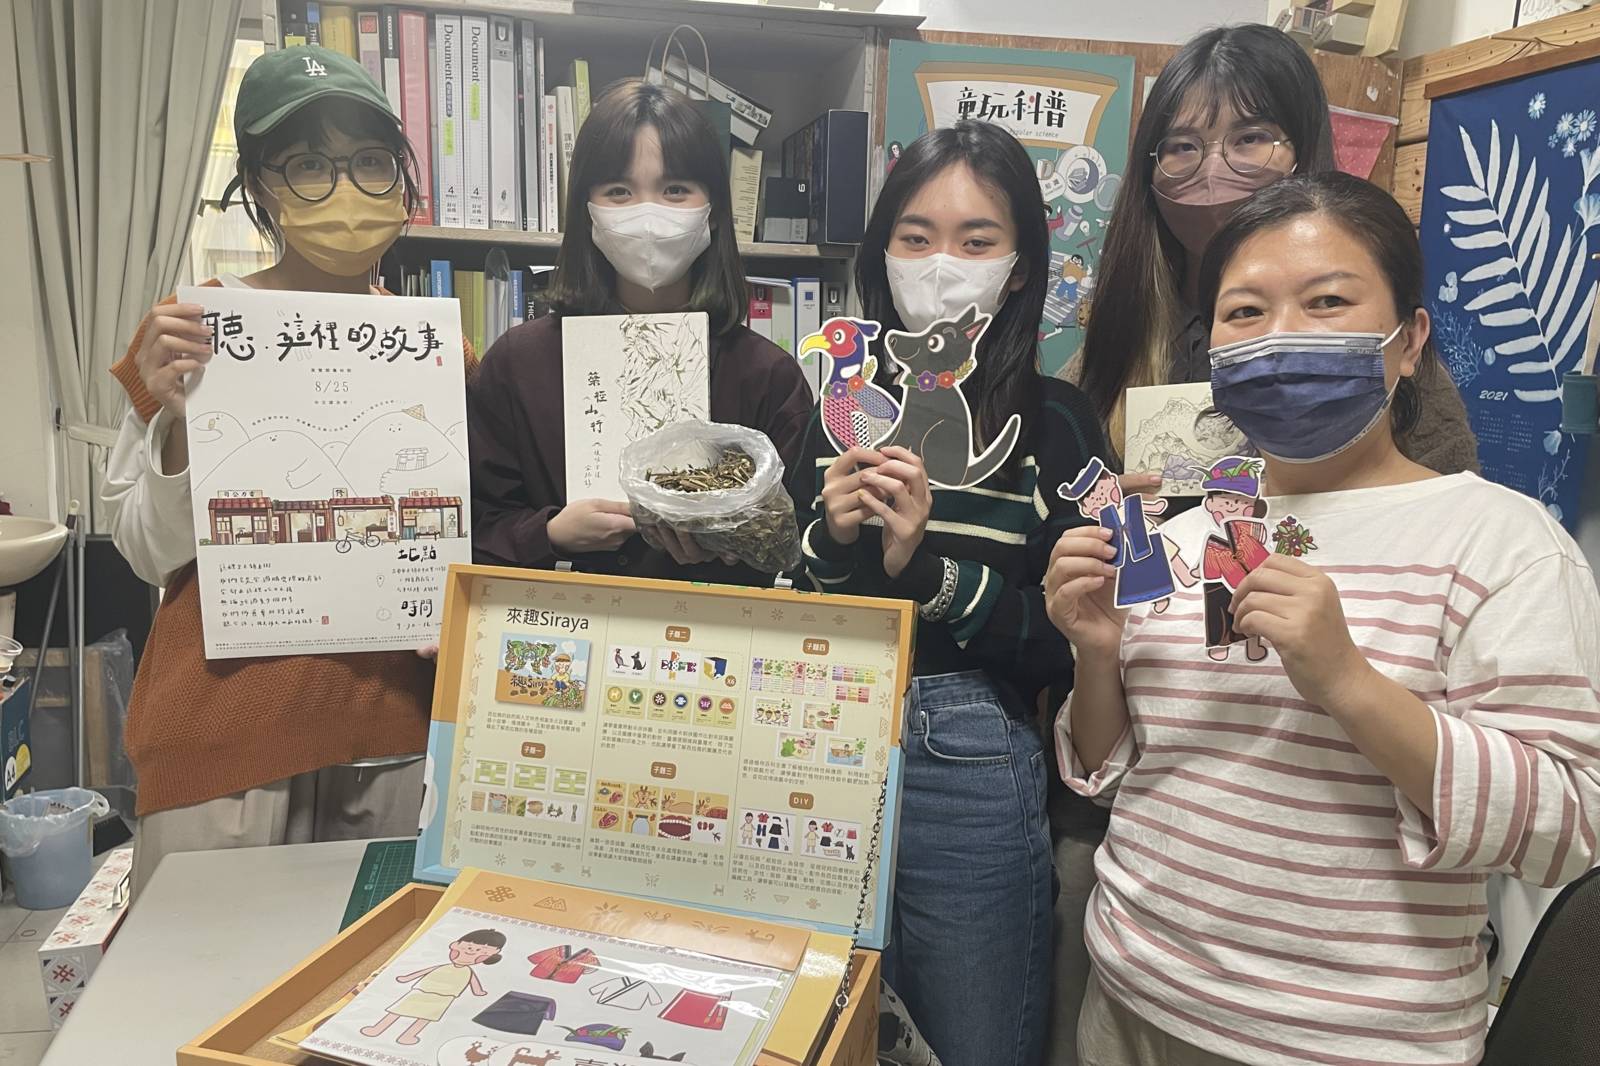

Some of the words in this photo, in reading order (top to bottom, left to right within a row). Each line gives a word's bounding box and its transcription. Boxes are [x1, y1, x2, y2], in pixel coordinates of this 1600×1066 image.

[444, 24, 453, 80] Document
[471, 26, 480, 81] Document
[302, 56, 328, 76] LA
[956, 86, 1067, 128] 童玩科普
[315, 380, 349, 393] 8/25
[1479, 390, 1508, 401] 2021
[401, 599, 433, 617] 時間
[506, 607, 589, 632] 來趣Siraya
[6, 763, 16, 786] A4
[793, 797, 810, 806] DIY
